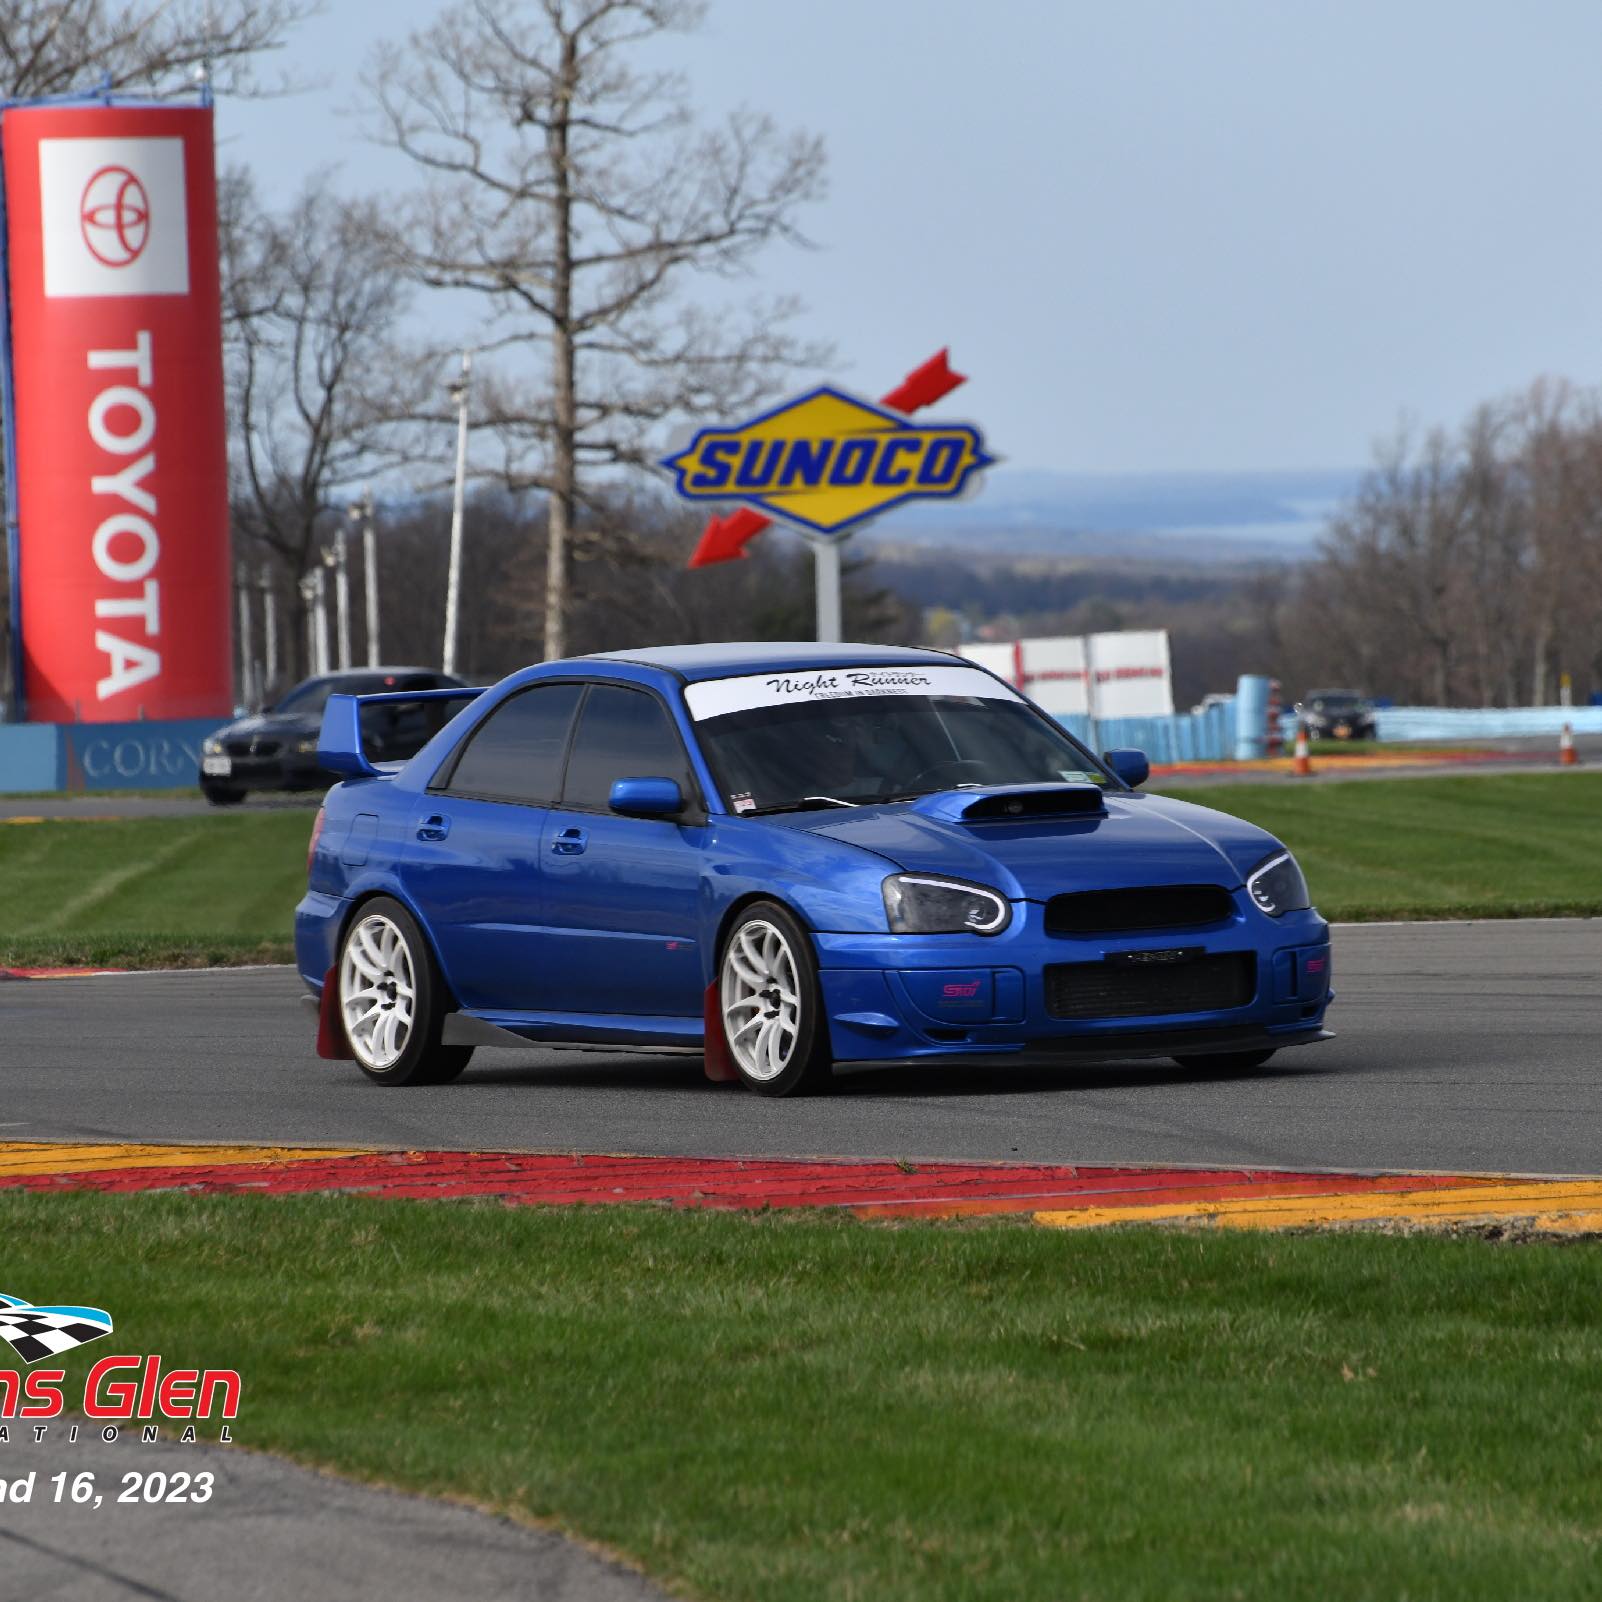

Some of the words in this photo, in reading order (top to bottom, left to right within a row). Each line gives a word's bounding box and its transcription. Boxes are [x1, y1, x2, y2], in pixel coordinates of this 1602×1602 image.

[690, 438, 966, 487] SUNOCO
[86, 331, 162, 700] TOYOTA
[766, 675, 840, 695] Night
[846, 673, 932, 687] Runner
